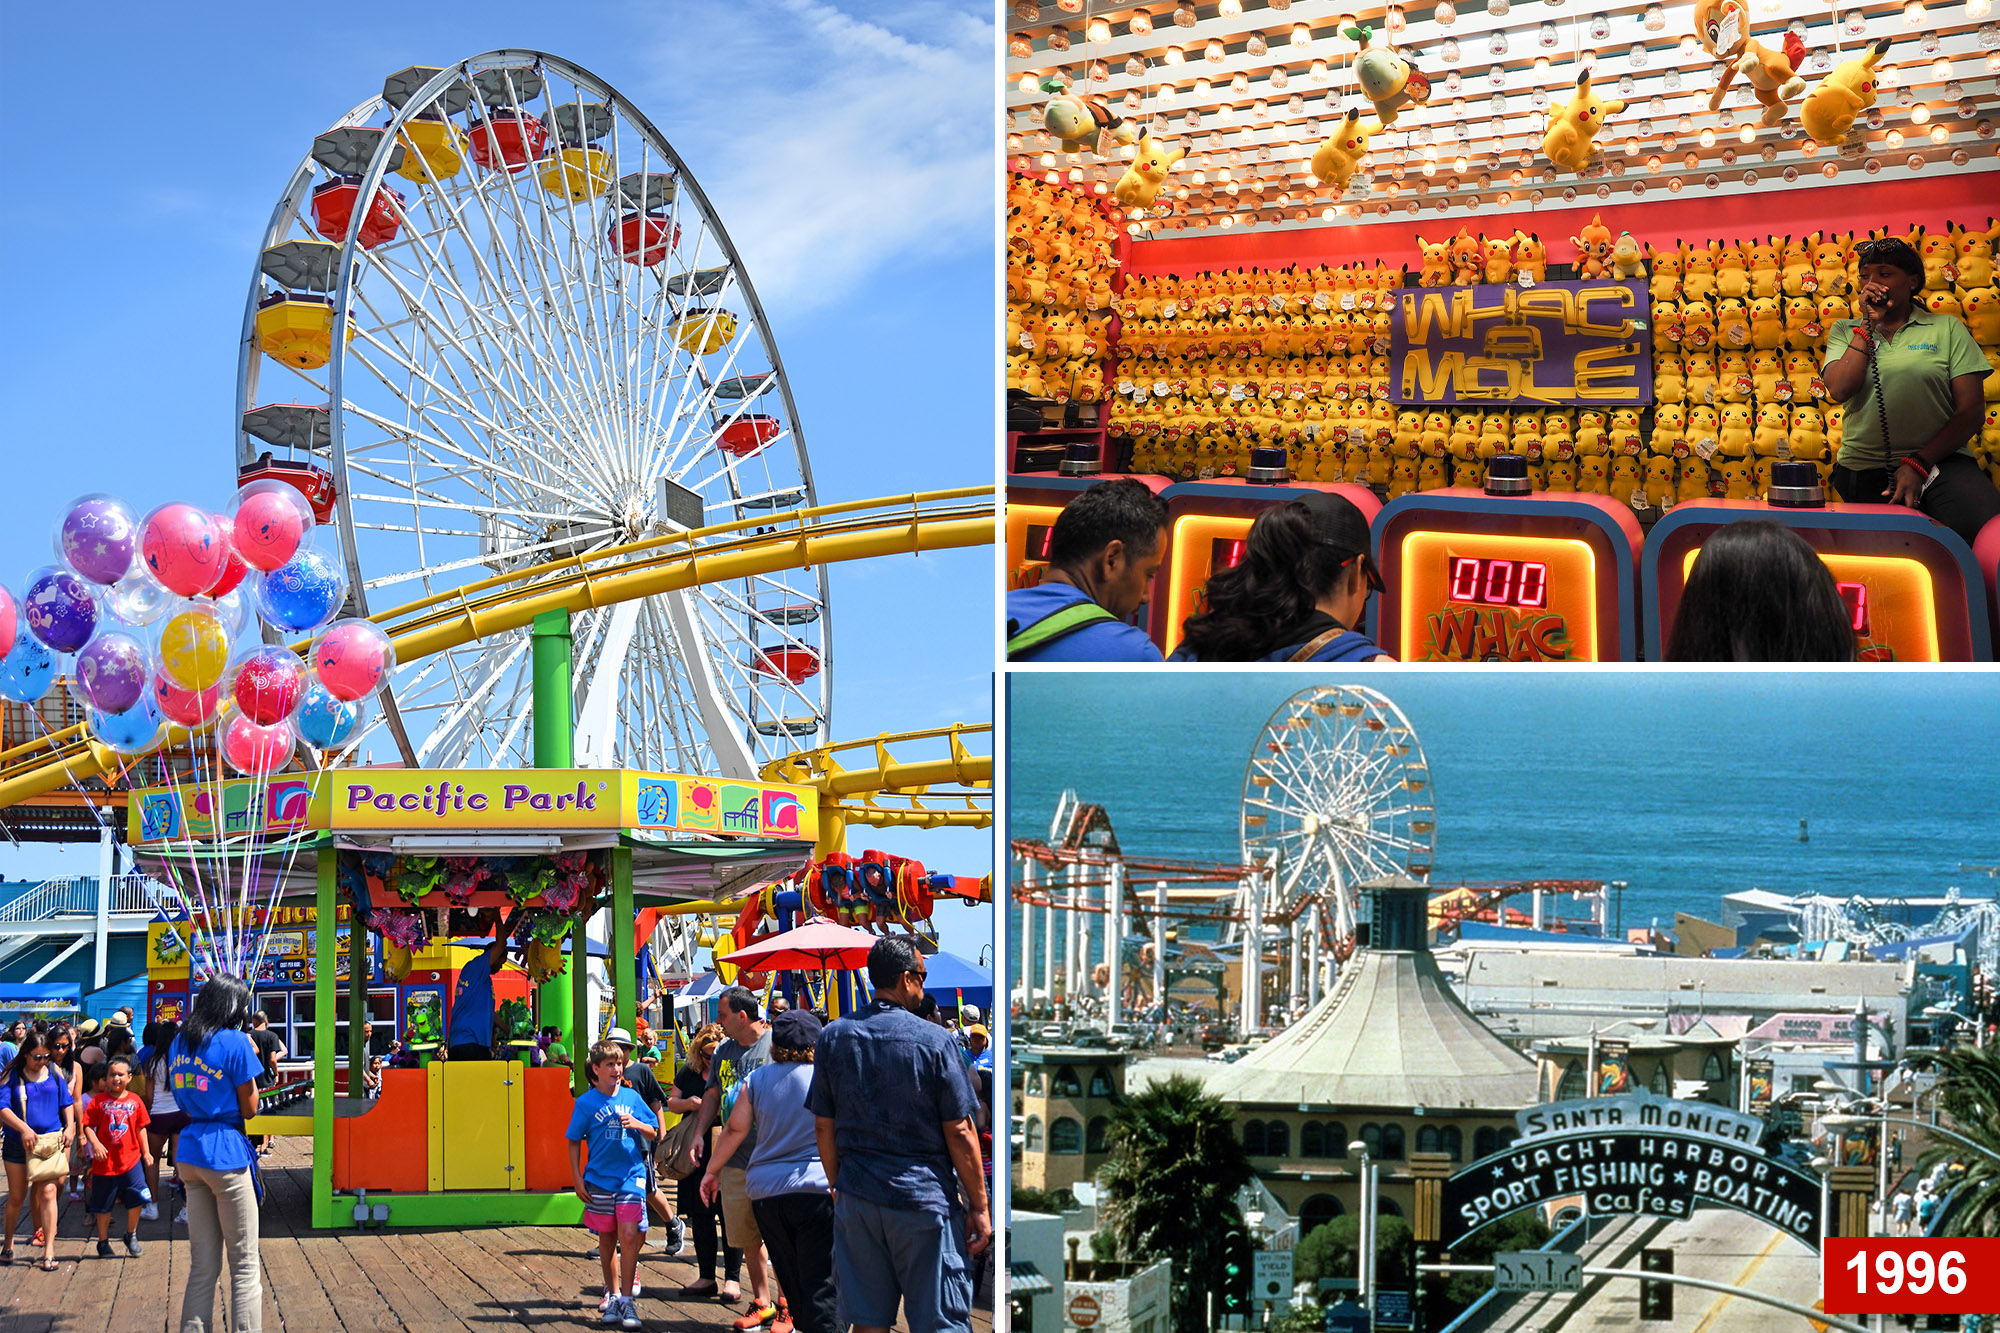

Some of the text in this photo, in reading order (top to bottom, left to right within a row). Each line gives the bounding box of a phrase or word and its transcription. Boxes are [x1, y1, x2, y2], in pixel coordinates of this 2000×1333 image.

[1402, 286, 1635, 346] WHAC
[1402, 342, 1641, 401] MOLE
[307, 484, 316, 493] 17
[1453, 558, 1546, 606] 000
[1427, 608, 1566, 662] WHAC
[347, 781, 489, 817] Pacific
[194, 1056, 224, 1080] Park
[594, 1104, 614, 1123] OLD
[1527, 1107, 1623, 1136] SANTA
[1640, 1103, 1750, 1141] MONICA
[1512, 1138, 1770, 1181] YACHT HARBOR
[1460, 1162, 1814, 1234] SPORT FISHING BOATING
